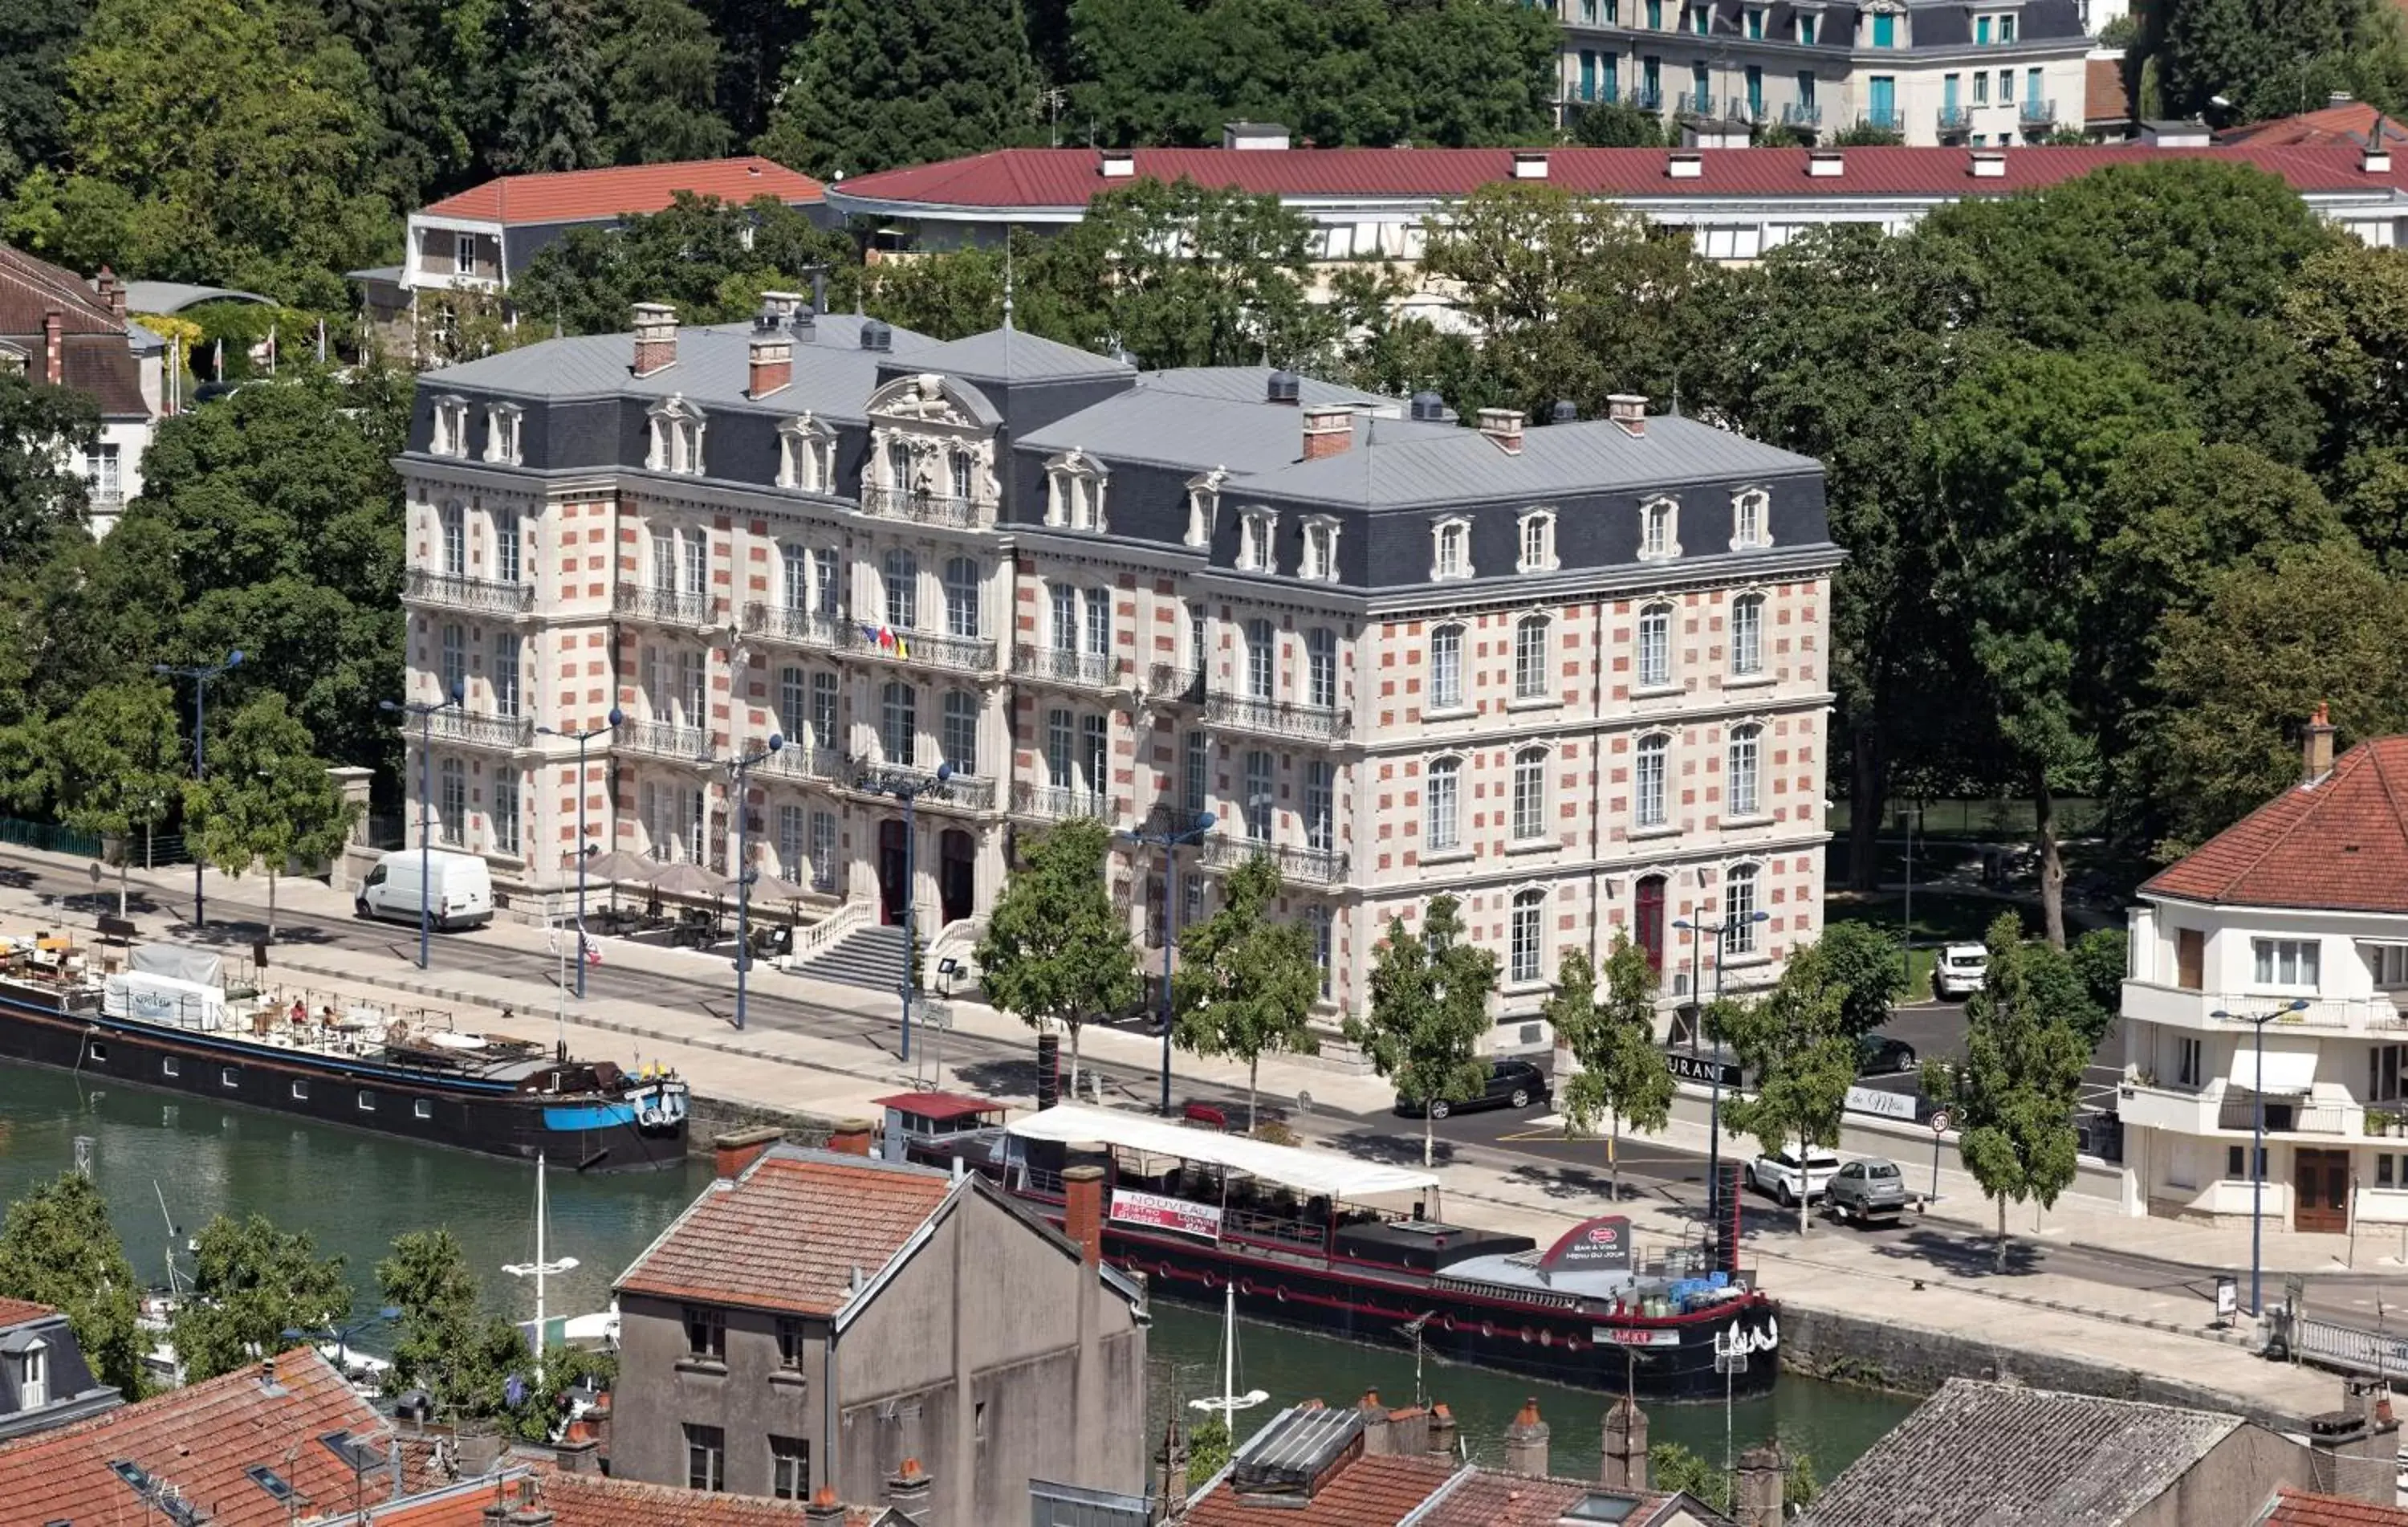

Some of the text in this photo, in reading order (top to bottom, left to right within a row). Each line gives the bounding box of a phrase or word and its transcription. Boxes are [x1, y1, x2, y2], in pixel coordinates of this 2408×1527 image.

[1668, 1057, 1726, 1081] URANT
[1935, 1117, 1947, 1129] 30
[1131, 1194, 1209, 1216] NOUVEAU
